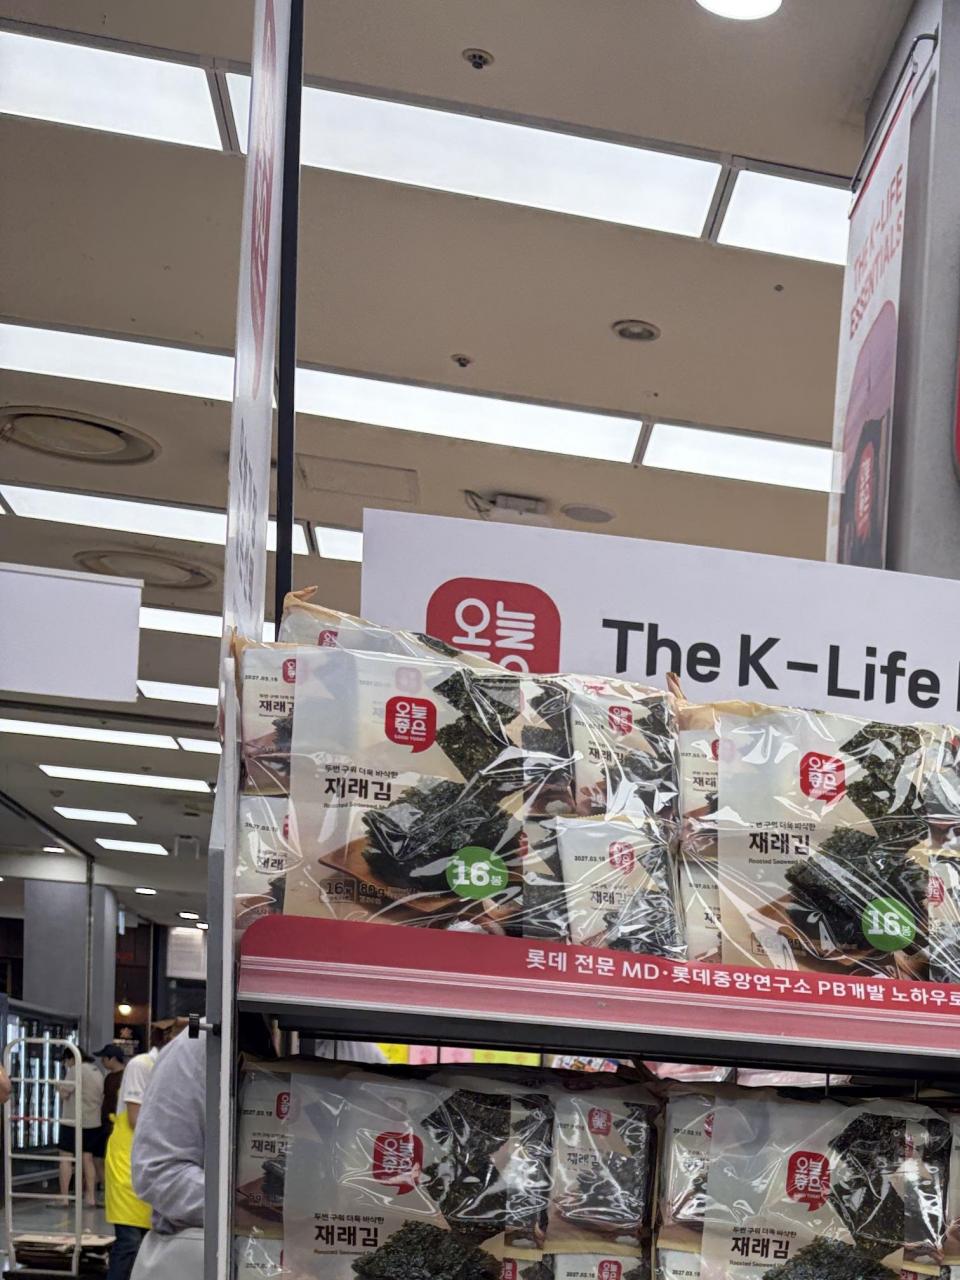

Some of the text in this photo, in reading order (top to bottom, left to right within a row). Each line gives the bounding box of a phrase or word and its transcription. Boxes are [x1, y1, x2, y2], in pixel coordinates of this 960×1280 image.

[601, 618, 721, 684] The
[396, 702, 428, 718] 오늘
[394, 716, 427, 735] 좋은
[375, 768, 399, 780] 바삭한
[808, 757, 838, 772] 오늘
[324, 778, 392, 801] 재래김
[808, 771, 837, 789] 좋은
[749, 833, 810, 855] 재래김
[453, 861, 502, 886] 16봉
[868, 911, 912, 937] 16봉
[526, 949, 567, 972] 롯데
[575, 954, 616, 978] 전문
[818, 980, 886, 1002] PB개발
[315, 1225, 379, 1247] 재래김
[731, 1237, 790, 1259] 재래김
